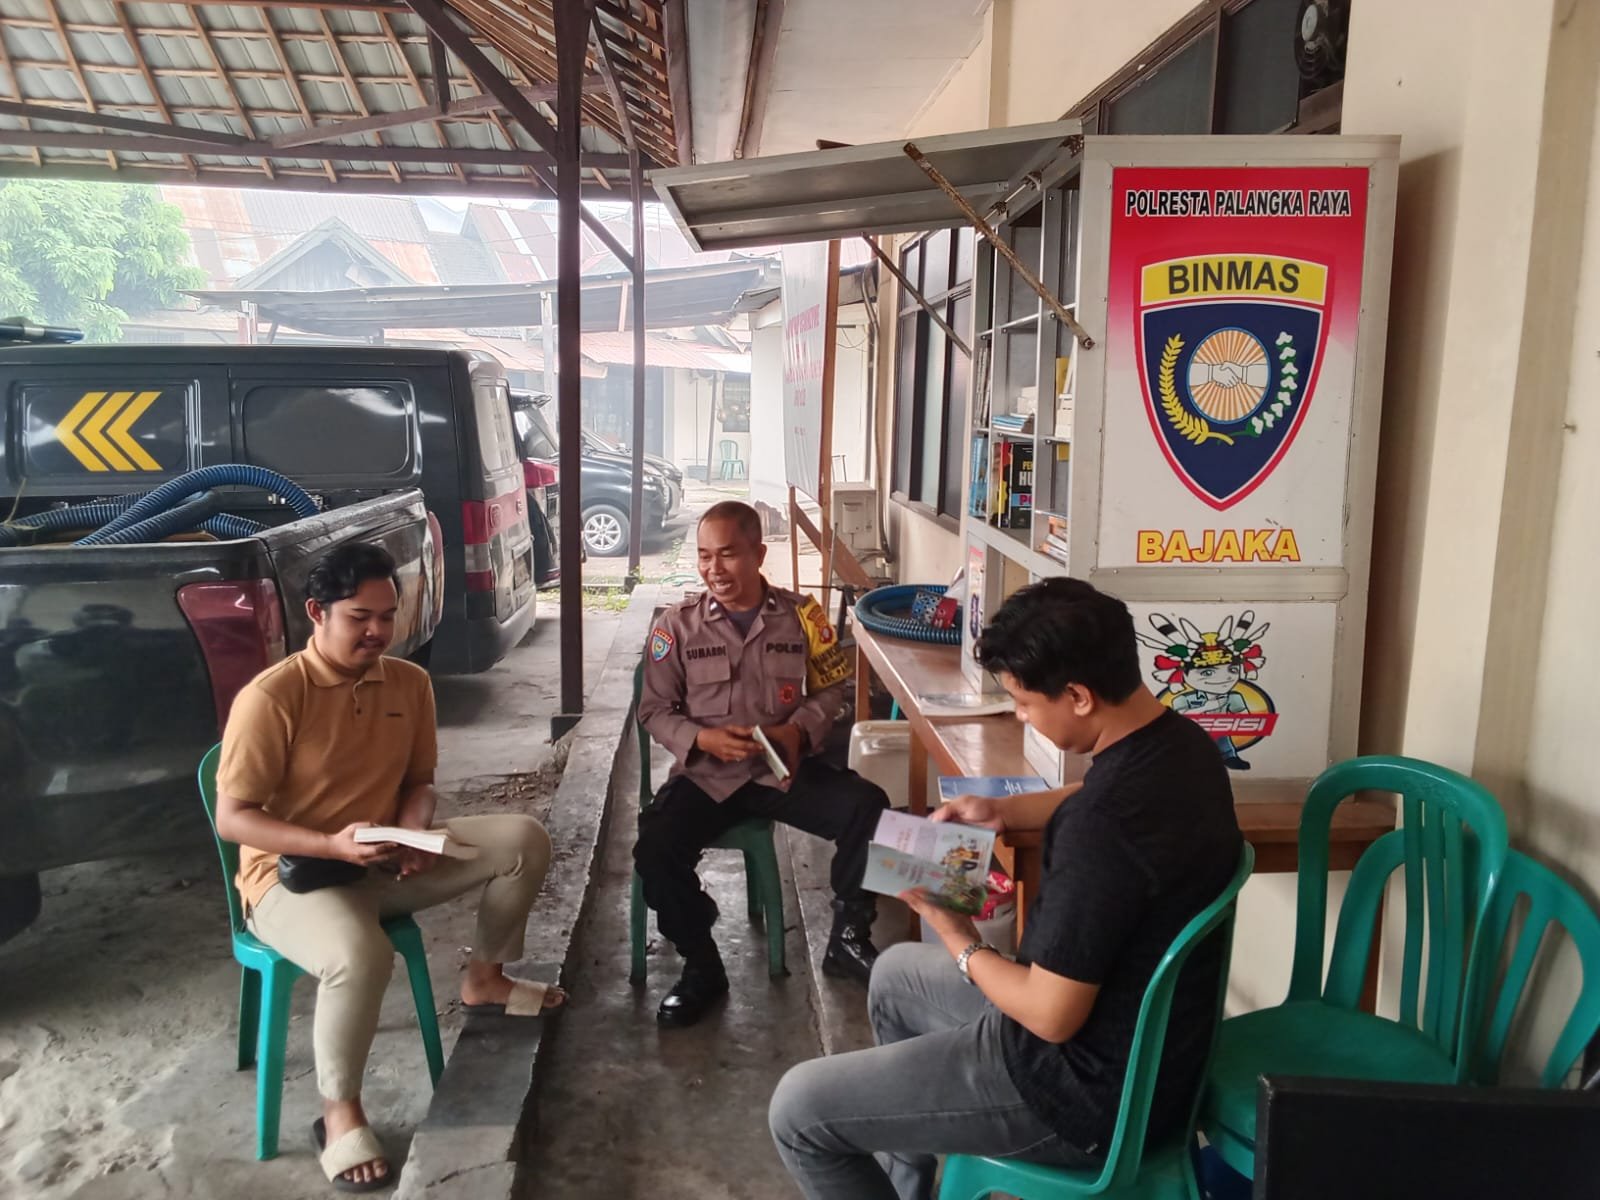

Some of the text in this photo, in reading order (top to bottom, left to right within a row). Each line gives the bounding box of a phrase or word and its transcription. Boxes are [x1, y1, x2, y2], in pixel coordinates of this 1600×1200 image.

[1126, 190, 1351, 216] POLRESTA PALANGKA RAYA
[1168, 261, 1300, 294] BINMAS
[1137, 529, 1301, 563] BAJAKA
[766, 642, 804, 654] POLRI
[1193, 718, 1267, 731] ESISI
